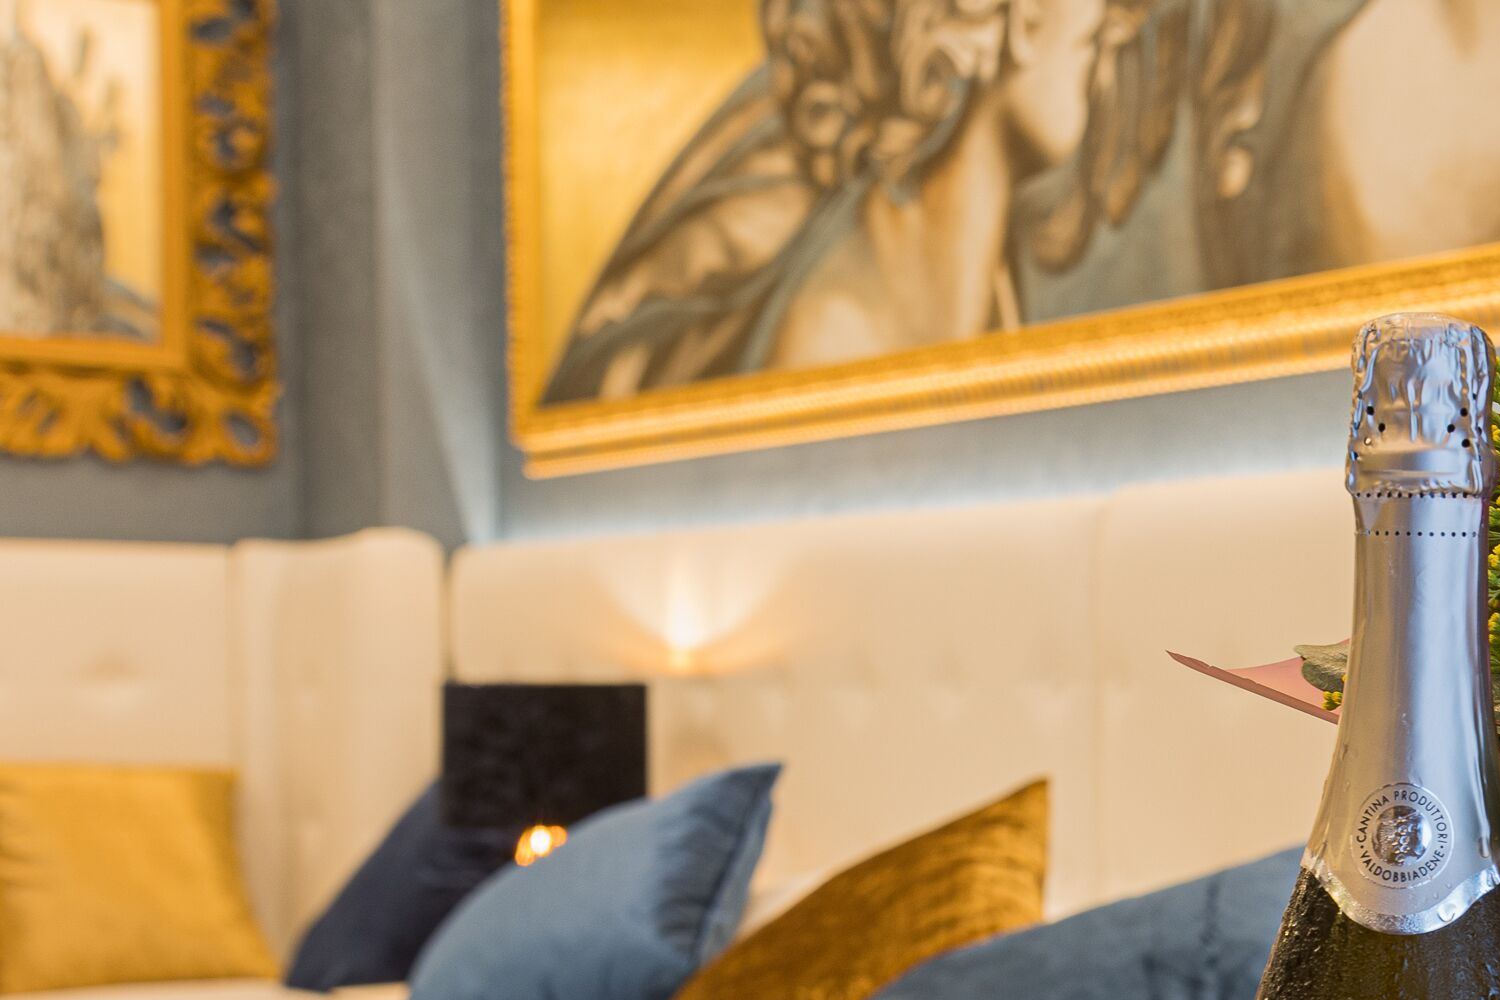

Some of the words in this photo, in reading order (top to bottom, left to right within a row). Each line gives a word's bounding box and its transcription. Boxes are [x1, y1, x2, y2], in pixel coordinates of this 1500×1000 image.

[1356, 795, 1390, 843] CANTINA
[1394, 790, 1448, 844] PRODUTTORI
[1360, 850, 1445, 882] VALDOBBIADENE
